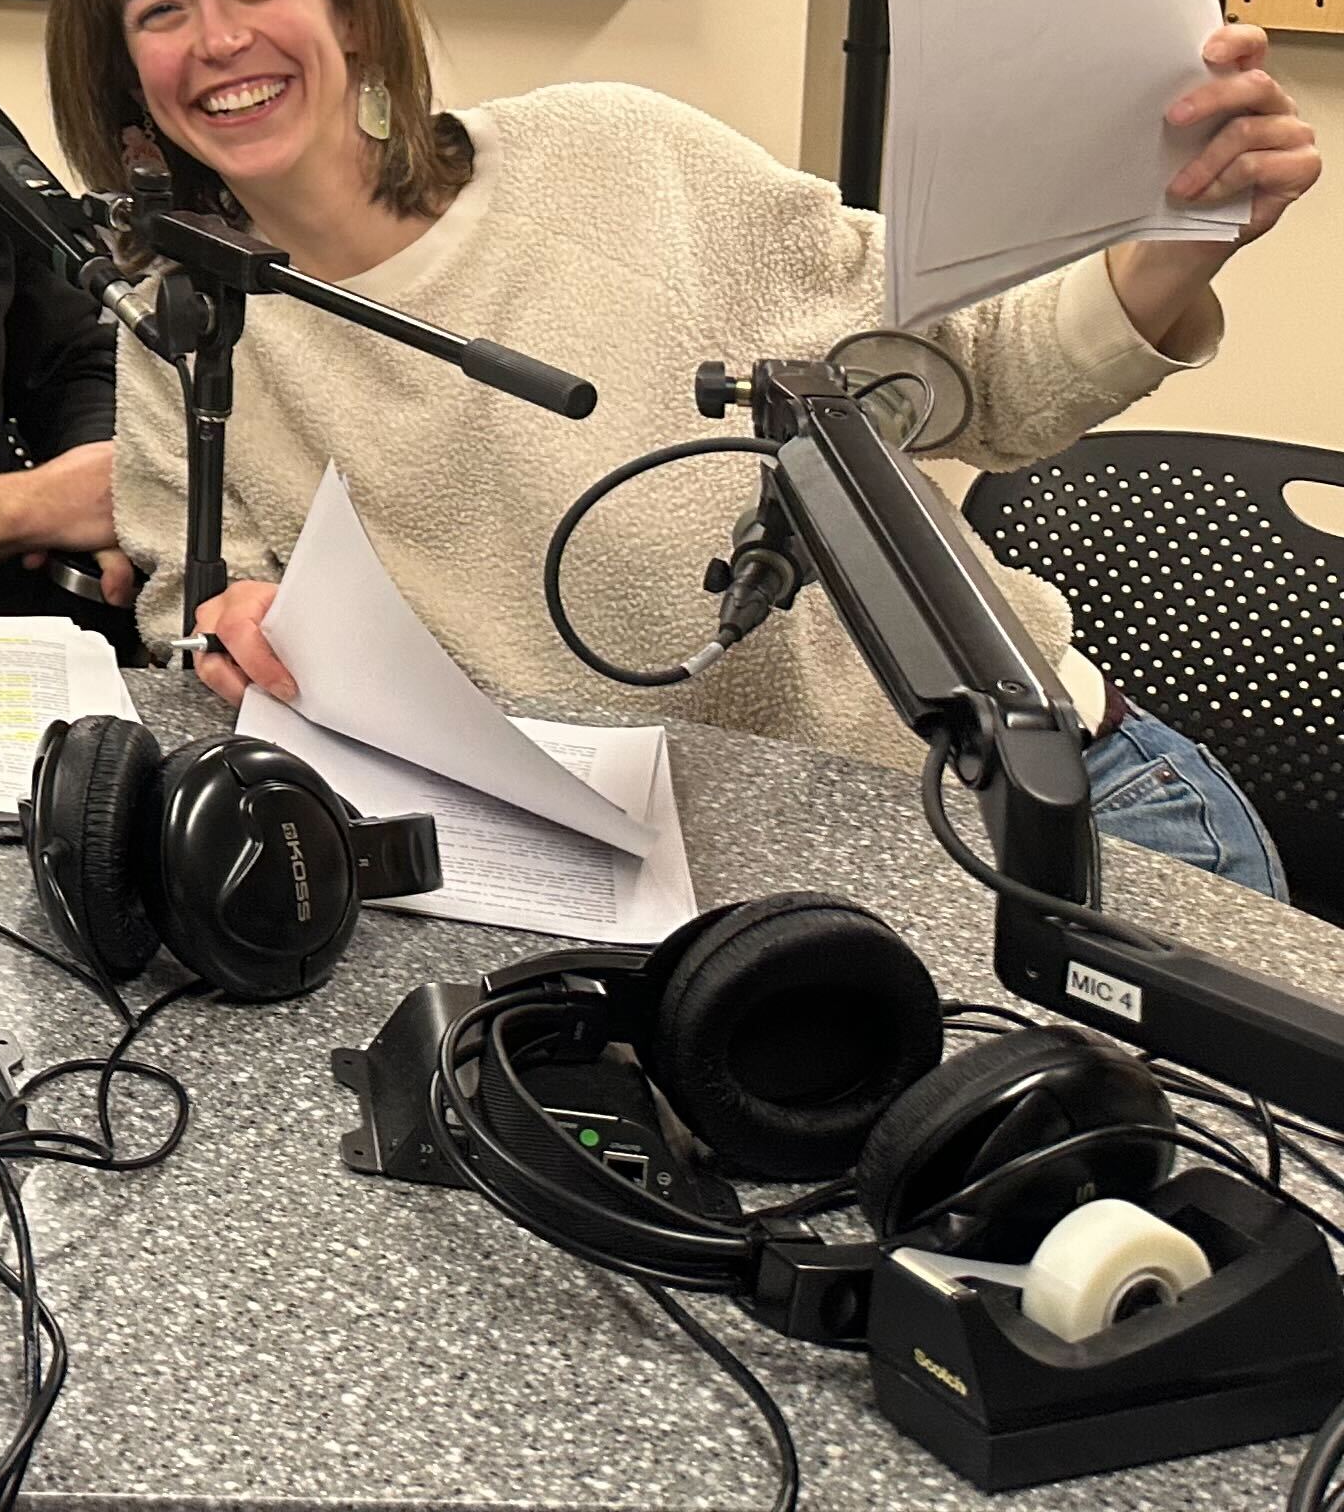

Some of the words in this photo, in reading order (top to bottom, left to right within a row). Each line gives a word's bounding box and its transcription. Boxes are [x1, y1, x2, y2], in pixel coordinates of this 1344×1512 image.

[286, 840, 312, 922] KOSS
[1072, 971, 1114, 1001] MIC
[1119, 992, 1132, 1010] 4
[913, 1348, 968, 1396] Scotch
